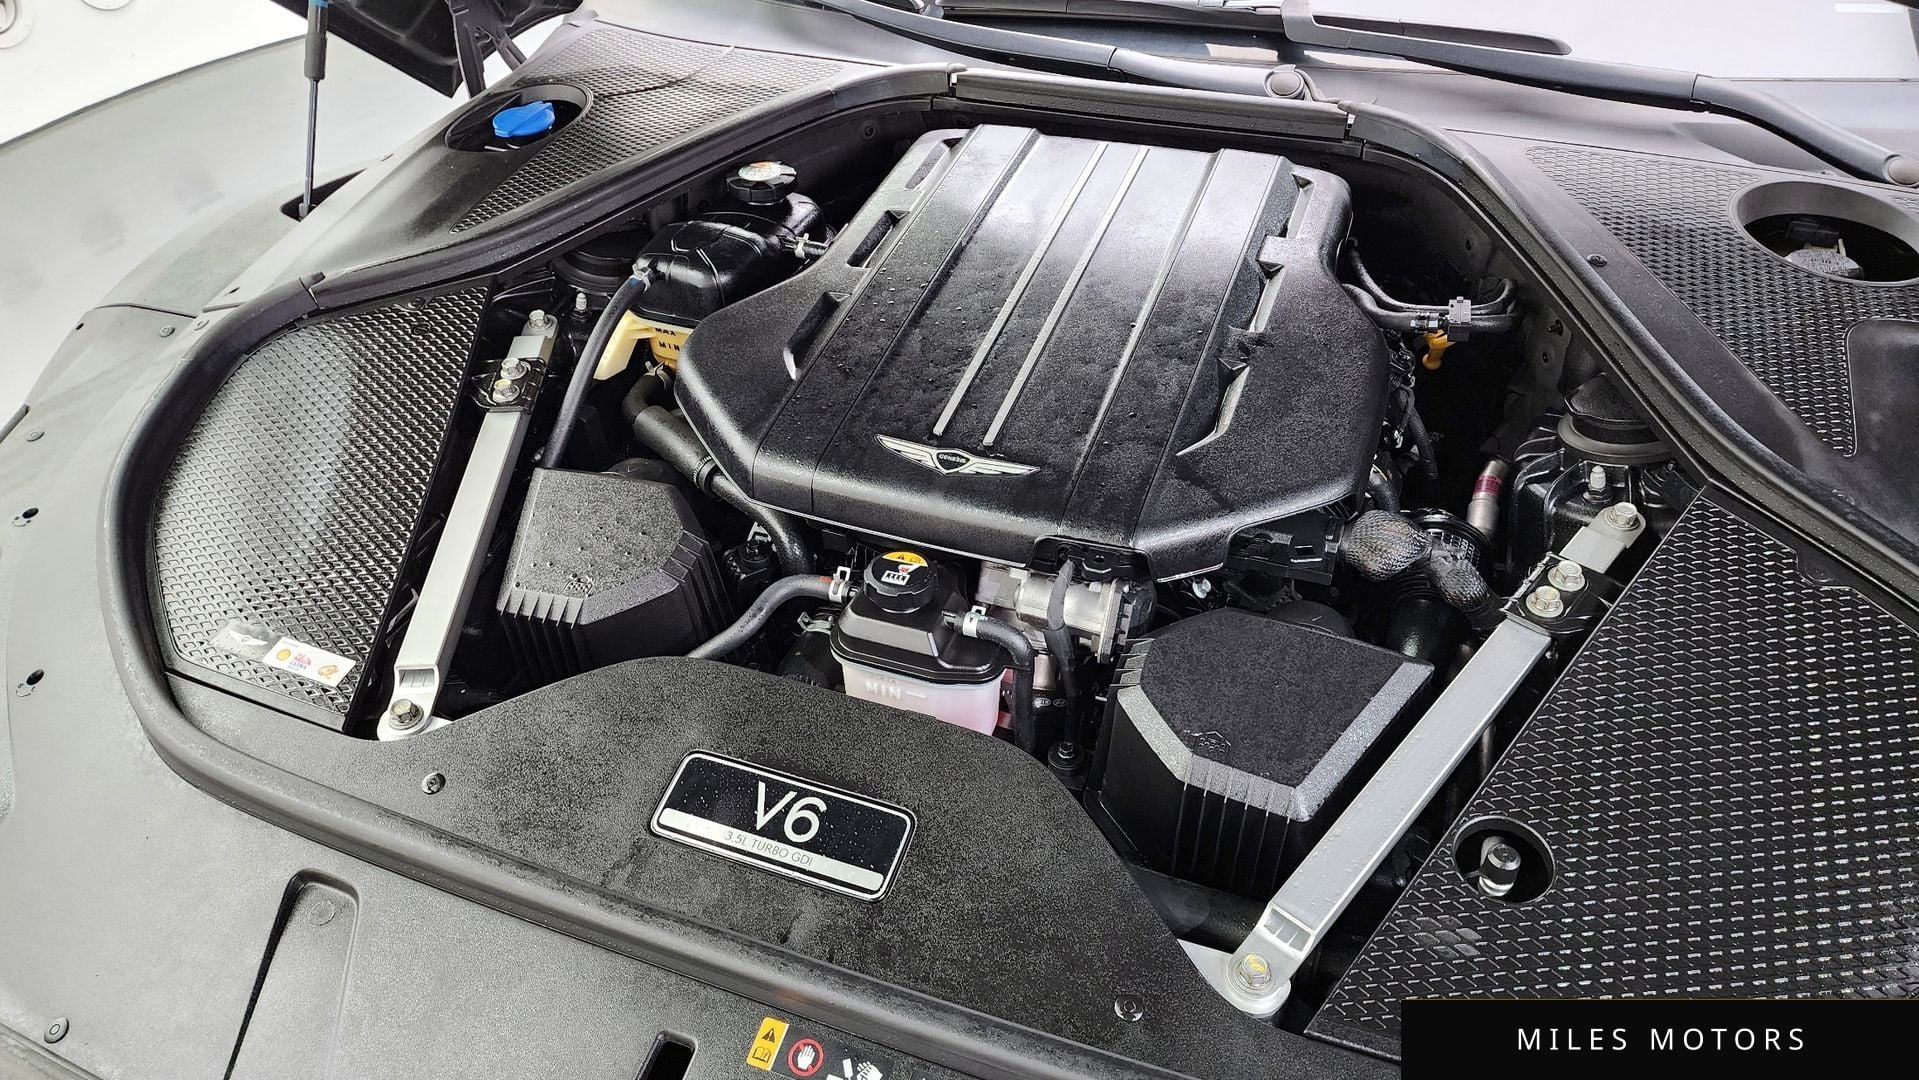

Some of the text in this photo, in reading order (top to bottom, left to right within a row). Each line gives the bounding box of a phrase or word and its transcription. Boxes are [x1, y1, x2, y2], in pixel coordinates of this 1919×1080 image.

[865, 680, 902, 700] MIN
[756, 780, 828, 843] V6
[724, 830, 814, 867] 3.5L TURBO GDI
